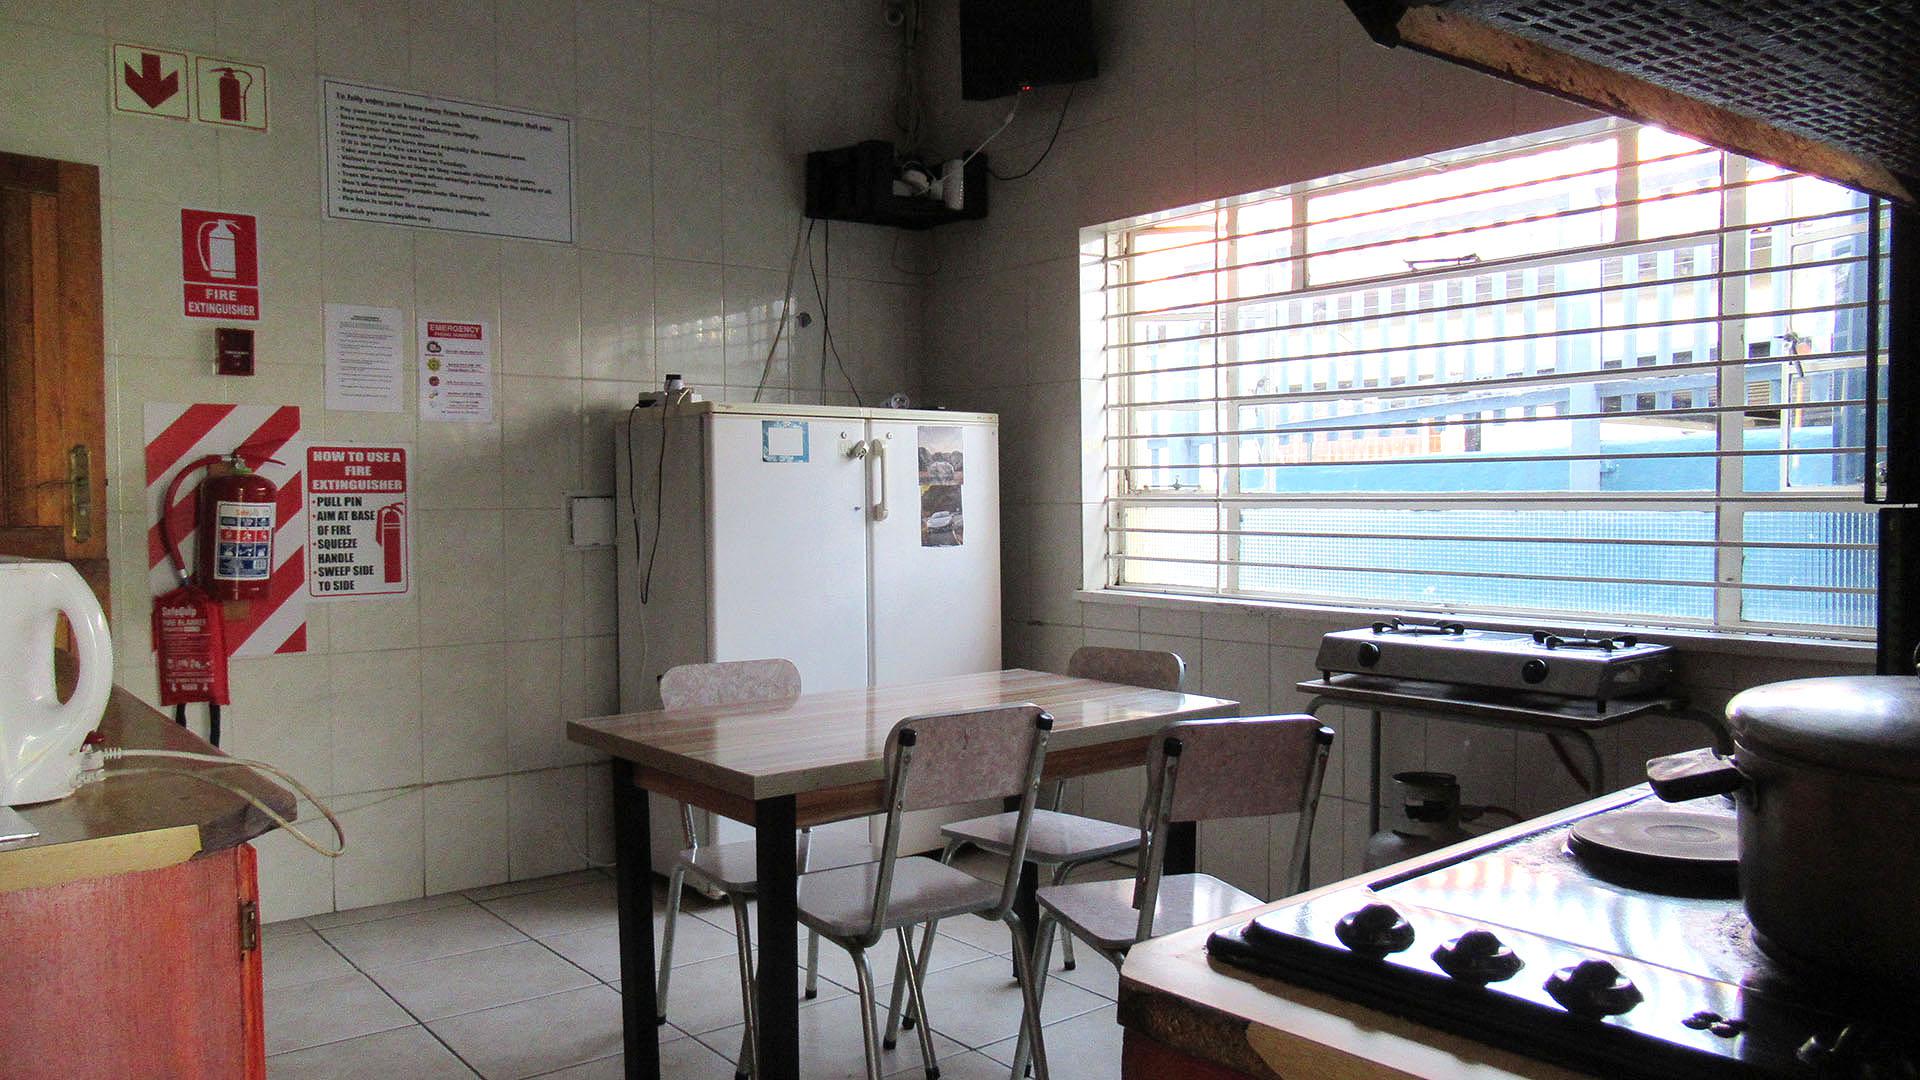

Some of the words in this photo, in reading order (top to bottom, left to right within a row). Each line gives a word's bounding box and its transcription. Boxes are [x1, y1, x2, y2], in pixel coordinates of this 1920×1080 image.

[206, 288, 237, 301] FIRE
[188, 302, 255, 316] EXTINGUISHER
[430, 324, 480, 332] EMERGENCY
[313, 451, 344, 461] HOW
[349, 452, 364, 462] TO
[367, 452, 390, 462] USE
[392, 452, 400, 462] A
[344, 466, 372, 476] FIRE
[312, 480, 402, 490] EXTINGUISHER
[317, 497, 342, 506] PULL
[344, 497, 362, 506] PIN
[317, 510, 338, 521] AIM
[340, 510, 350, 520] AT
[352, 510, 375, 520] BASE
[317, 525, 329, 536] OF
[331, 525, 352, 535] FIRE
[318, 538, 357, 550] SQUEEZE
[318, 553, 354, 563] HANDLE
[318, 566, 351, 577] SWEEP
[353, 566, 374, 575] SIDE
[319, 581, 331, 591] TO
[333, 581, 354, 590] SIDE
